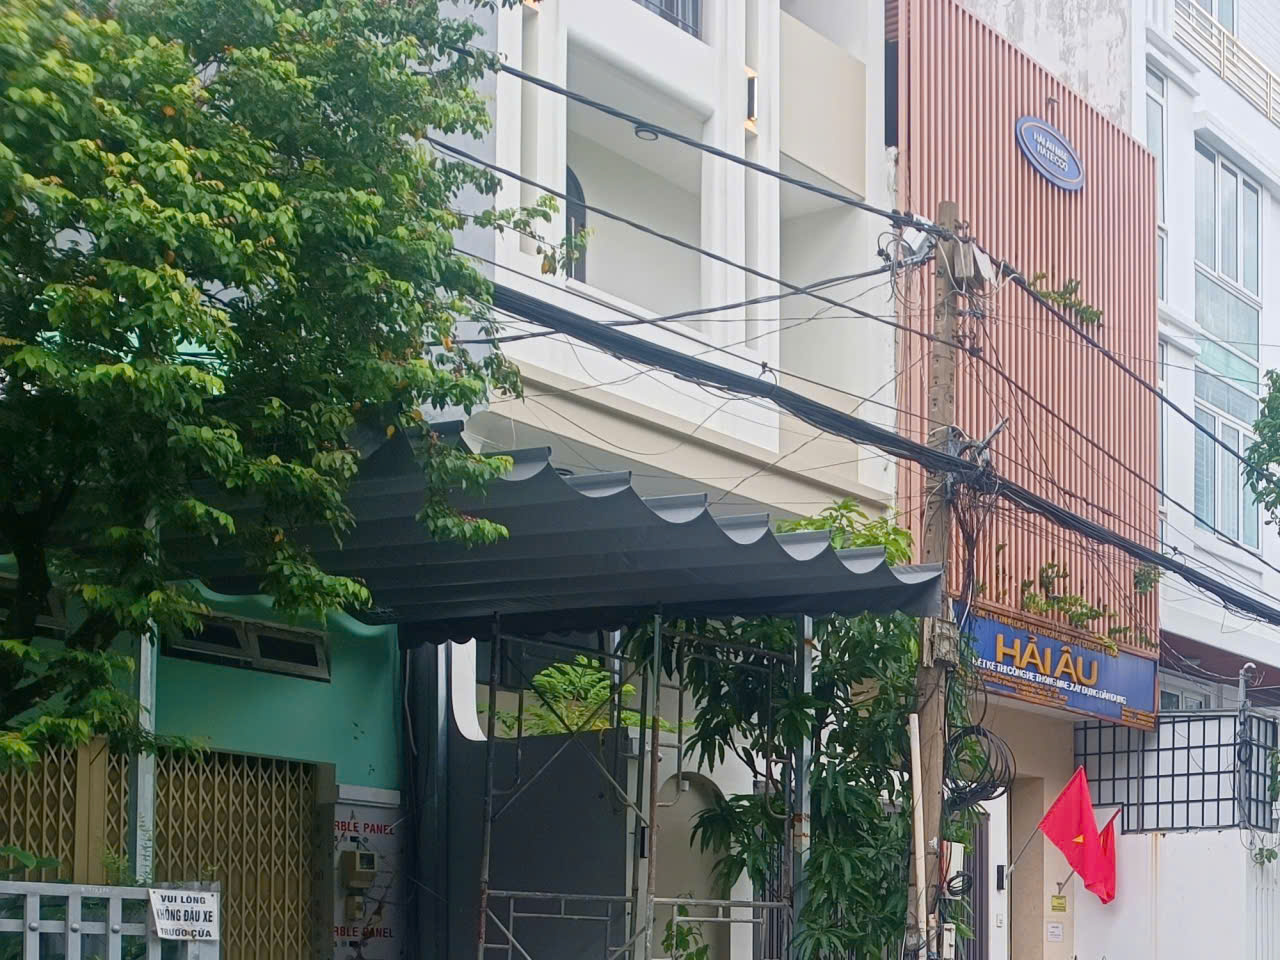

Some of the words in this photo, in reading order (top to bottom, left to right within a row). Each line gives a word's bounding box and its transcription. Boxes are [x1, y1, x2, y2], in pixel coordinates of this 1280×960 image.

[996, 633, 1051, 675] HẢI
[1054, 646, 1098, 685] ÂU
[334, 821, 359, 833] RBLE
[363, 823, 395, 835] PANEL
[160, 895, 177, 904] VUI
[202, 911, 213, 923] XE
[333, 926, 358, 937] RBLE
[362, 927, 394, 938] PANEL
